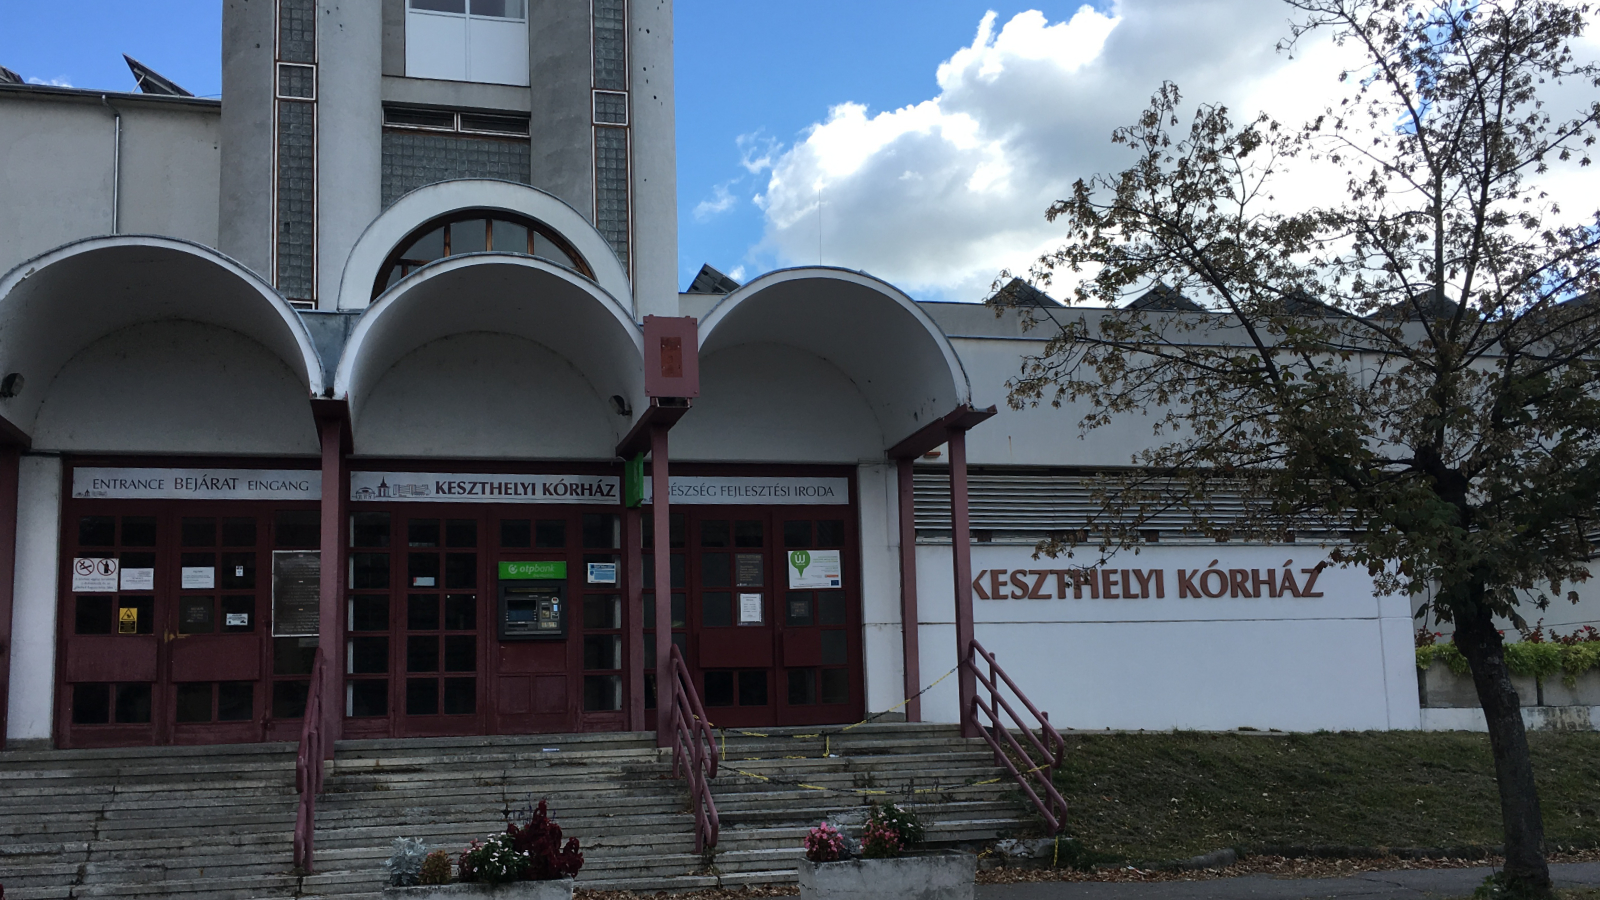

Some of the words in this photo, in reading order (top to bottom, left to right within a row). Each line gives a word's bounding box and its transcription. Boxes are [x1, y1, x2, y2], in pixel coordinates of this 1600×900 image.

[92, 478, 165, 490] ENTRANCE
[174, 474, 240, 492] BEJÁRAT
[247, 480, 309, 491] EINGANG
[435, 480, 536, 497] KESZTHELYI
[542, 478, 616, 498] KÓRHÁZ
[668, 482, 717, 498] ÉSZSÉG
[720, 483, 790, 498] FEJLESZTÉSI
[794, 485, 835, 497] IRODA
[972, 568, 1165, 600] KESZTHELYI
[1178, 559, 1324, 599] KÓRHÁZ
